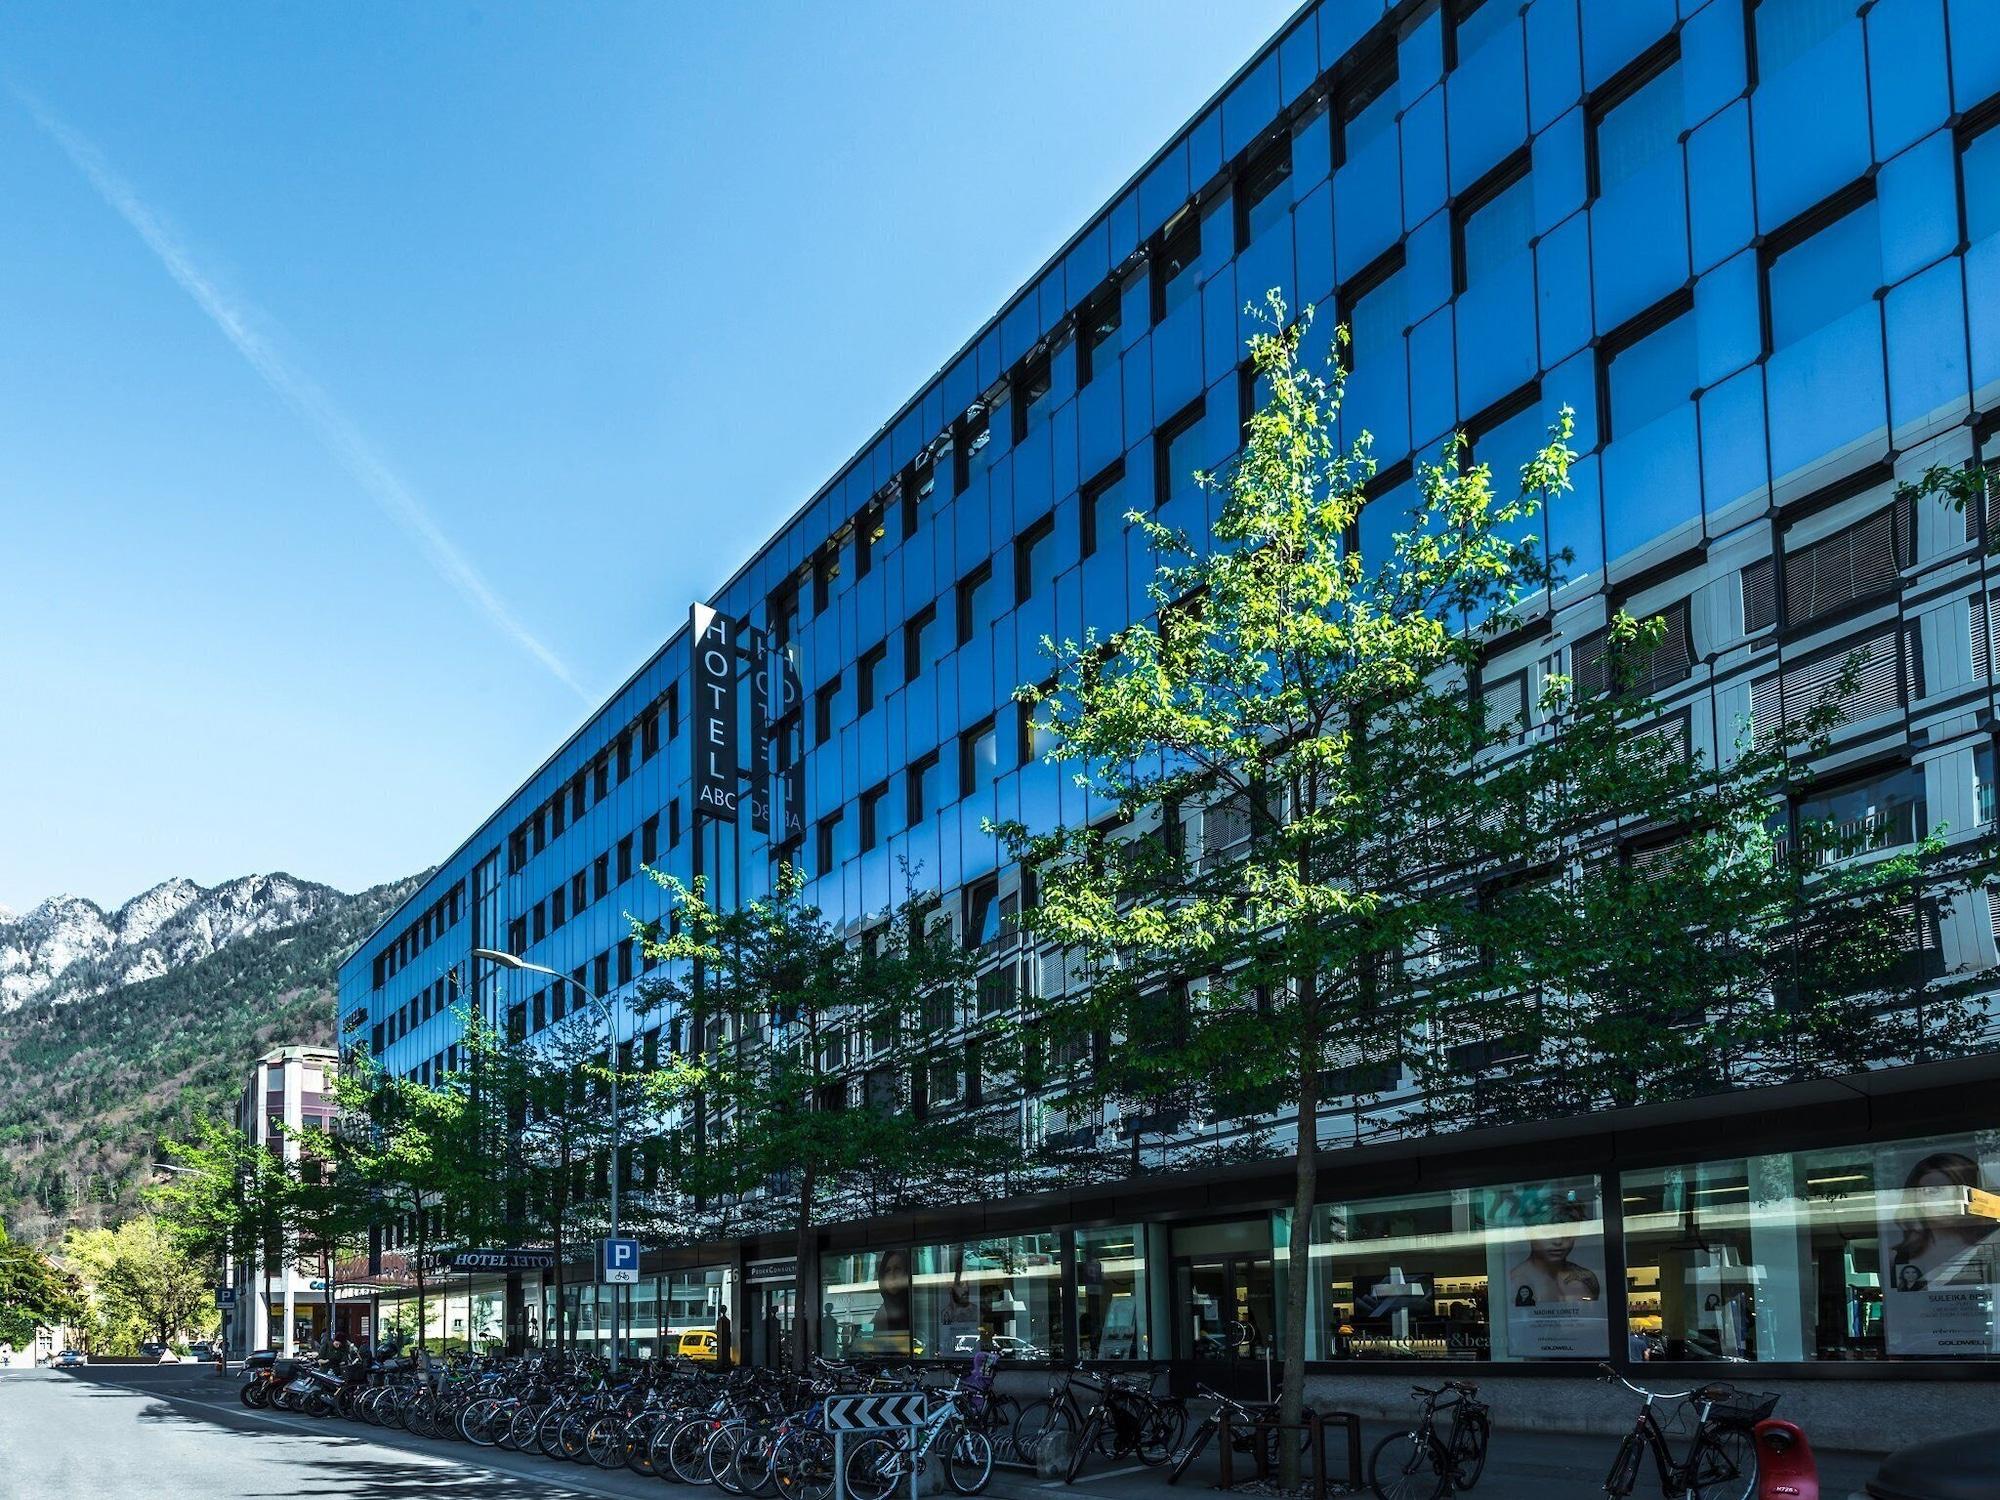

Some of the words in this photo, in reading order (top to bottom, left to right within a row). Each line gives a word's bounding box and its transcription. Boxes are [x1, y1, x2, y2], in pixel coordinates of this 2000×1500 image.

[704, 620, 728, 780] HOTEL
[700, 784, 736, 811] ABC
[454, 1254, 508, 1267] HOTEL
[615, 1244, 631, 1267] P
[221, 1290, 231, 1302] P
